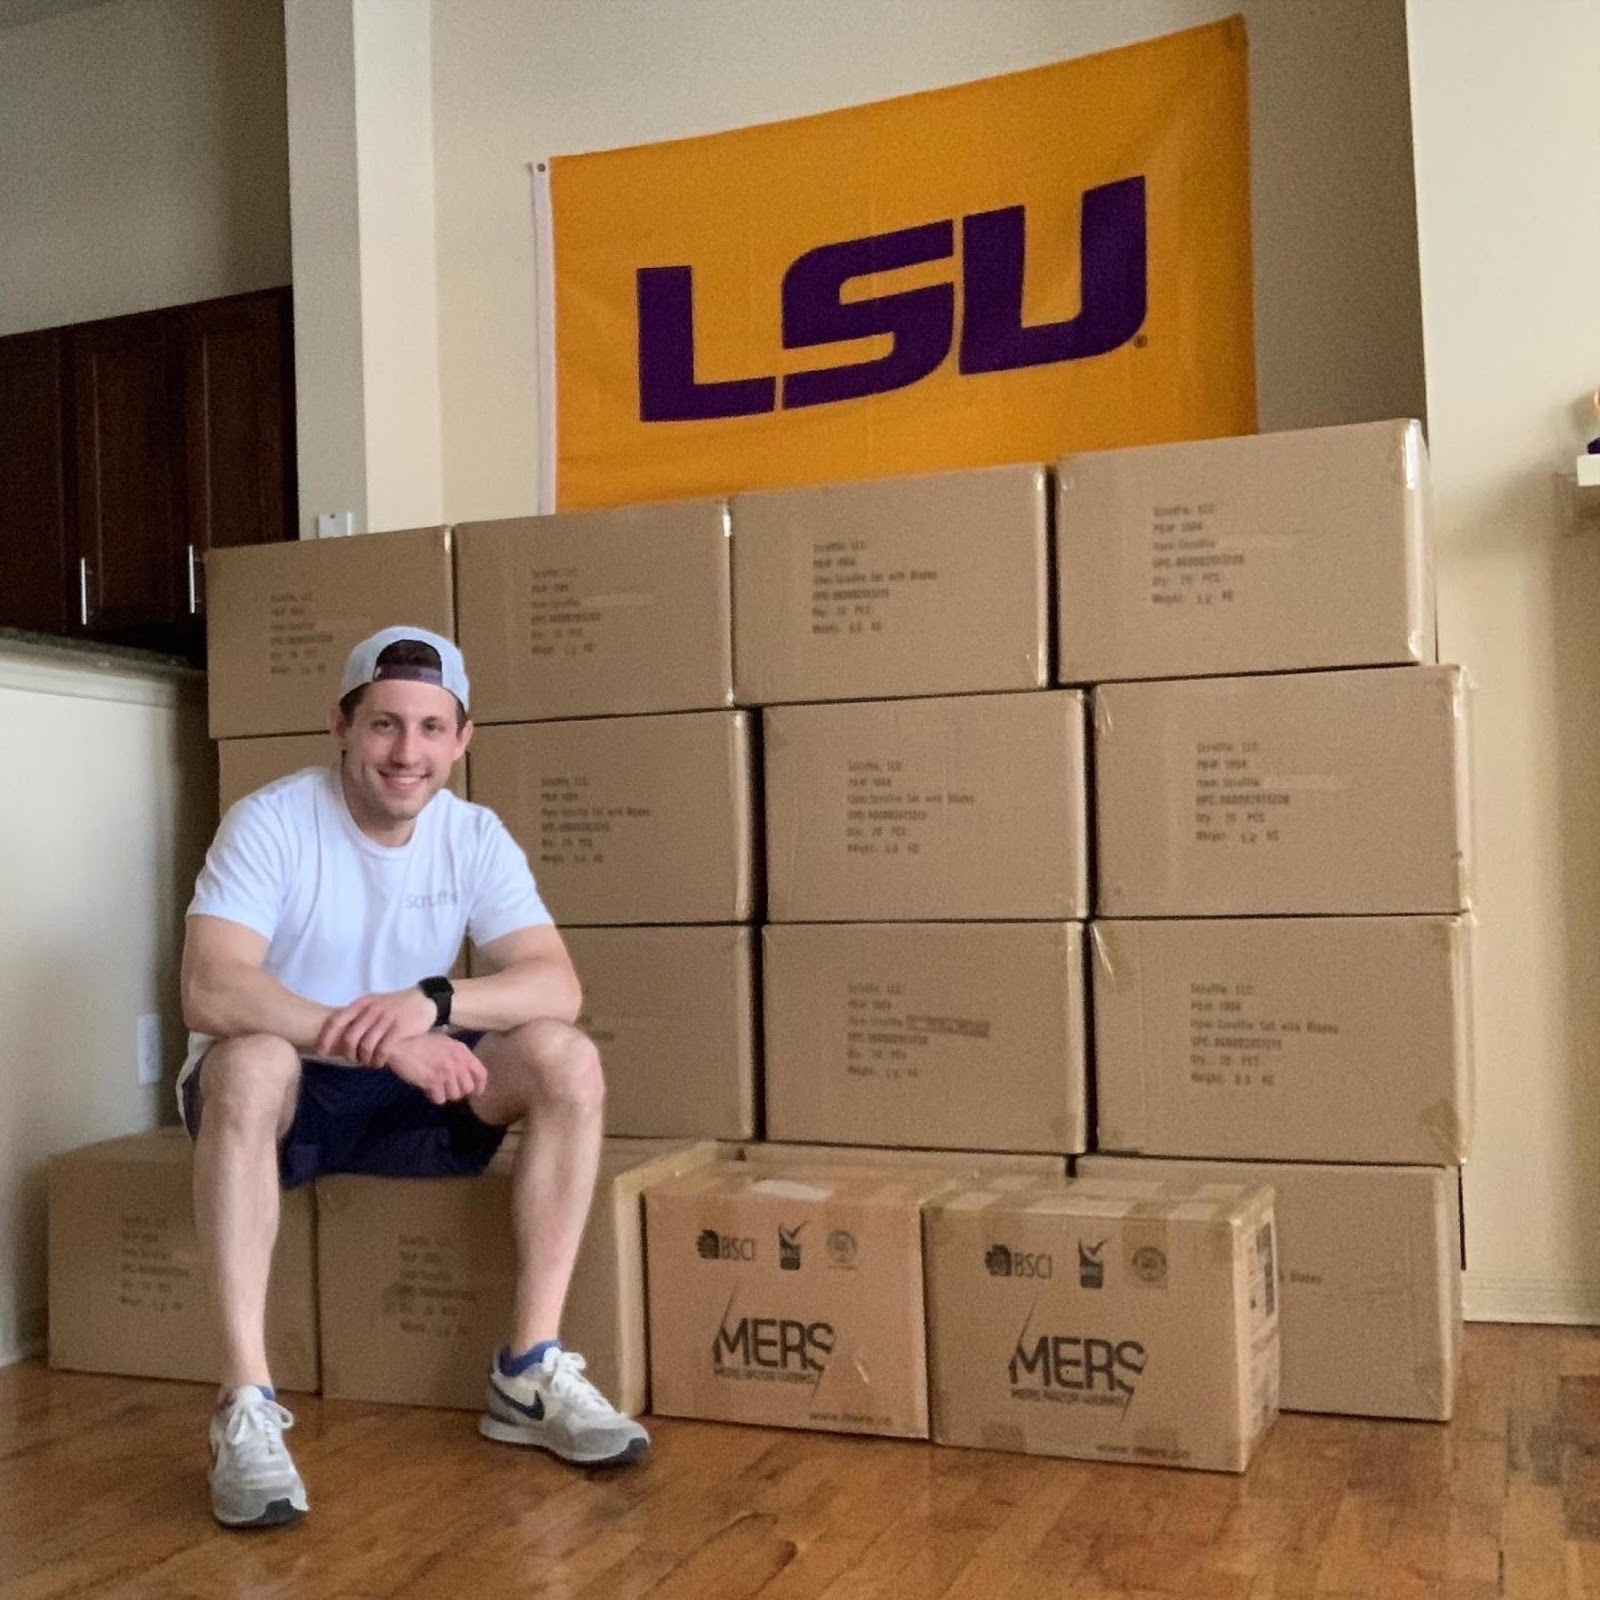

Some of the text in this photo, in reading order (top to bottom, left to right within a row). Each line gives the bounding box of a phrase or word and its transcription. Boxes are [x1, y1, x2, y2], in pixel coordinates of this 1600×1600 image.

[637, 175, 1147, 422] LSU
[1014, 1253, 1052, 1279] BSCI
[713, 1318, 835, 1373] MERS
[1008, 1336, 1147, 1394] MERS
